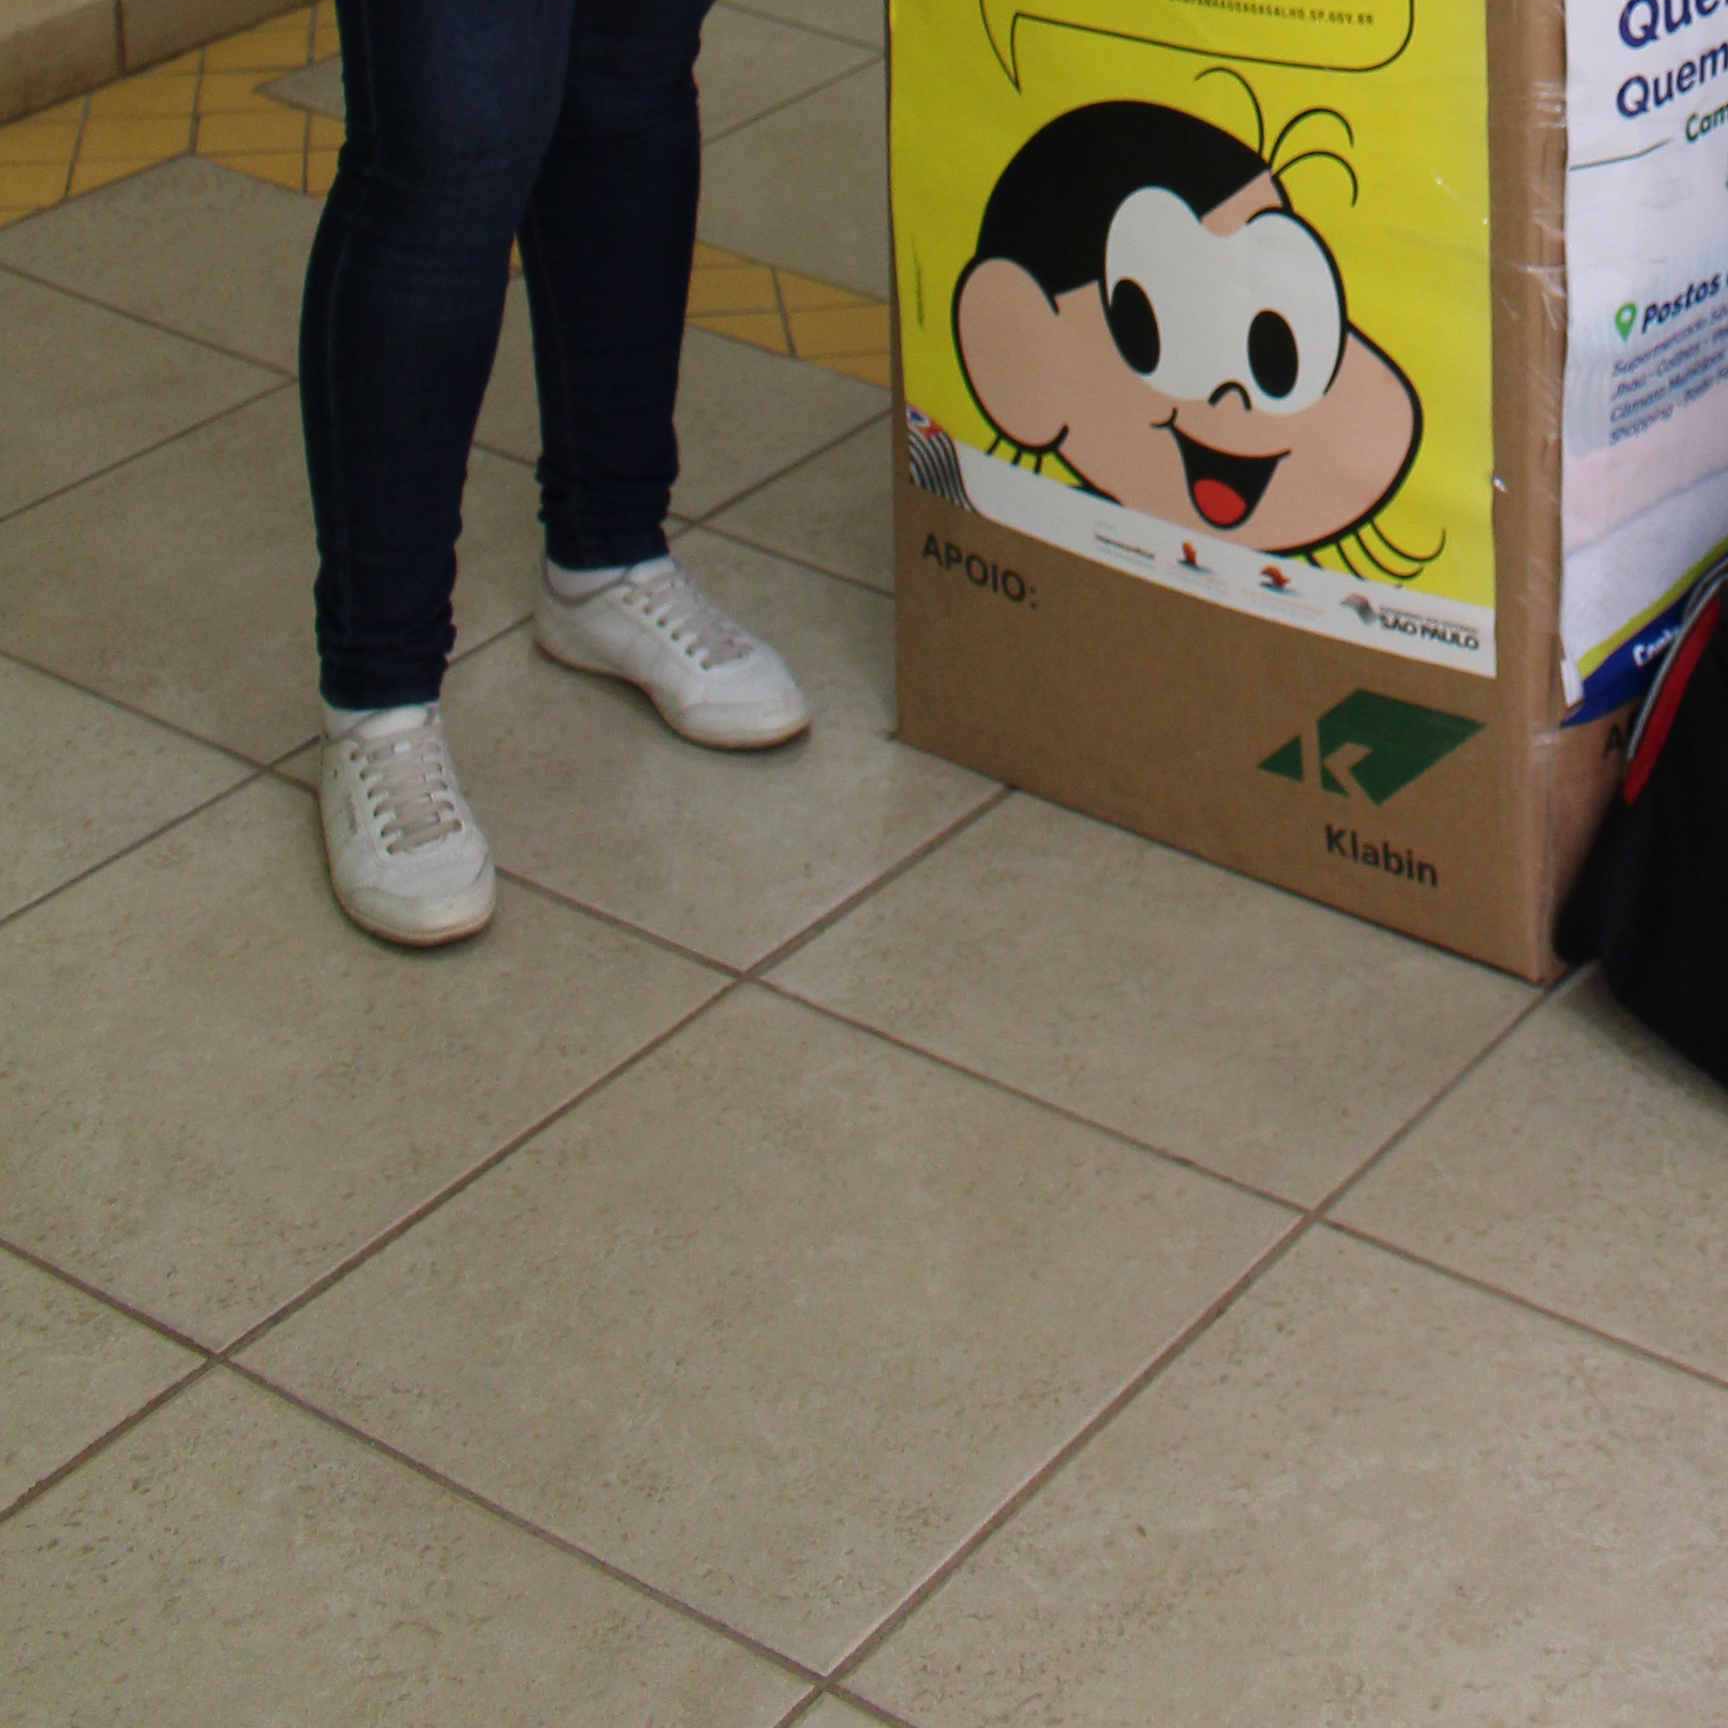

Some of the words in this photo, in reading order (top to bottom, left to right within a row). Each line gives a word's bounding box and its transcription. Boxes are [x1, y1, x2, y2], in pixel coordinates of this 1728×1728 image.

[1641, 272, 1722, 334] Postos
[920, 532, 1039, 610] APOIO:
[1420, 623, 1480, 653] PAULO
[1325, 823, 1439, 888] Klabin
